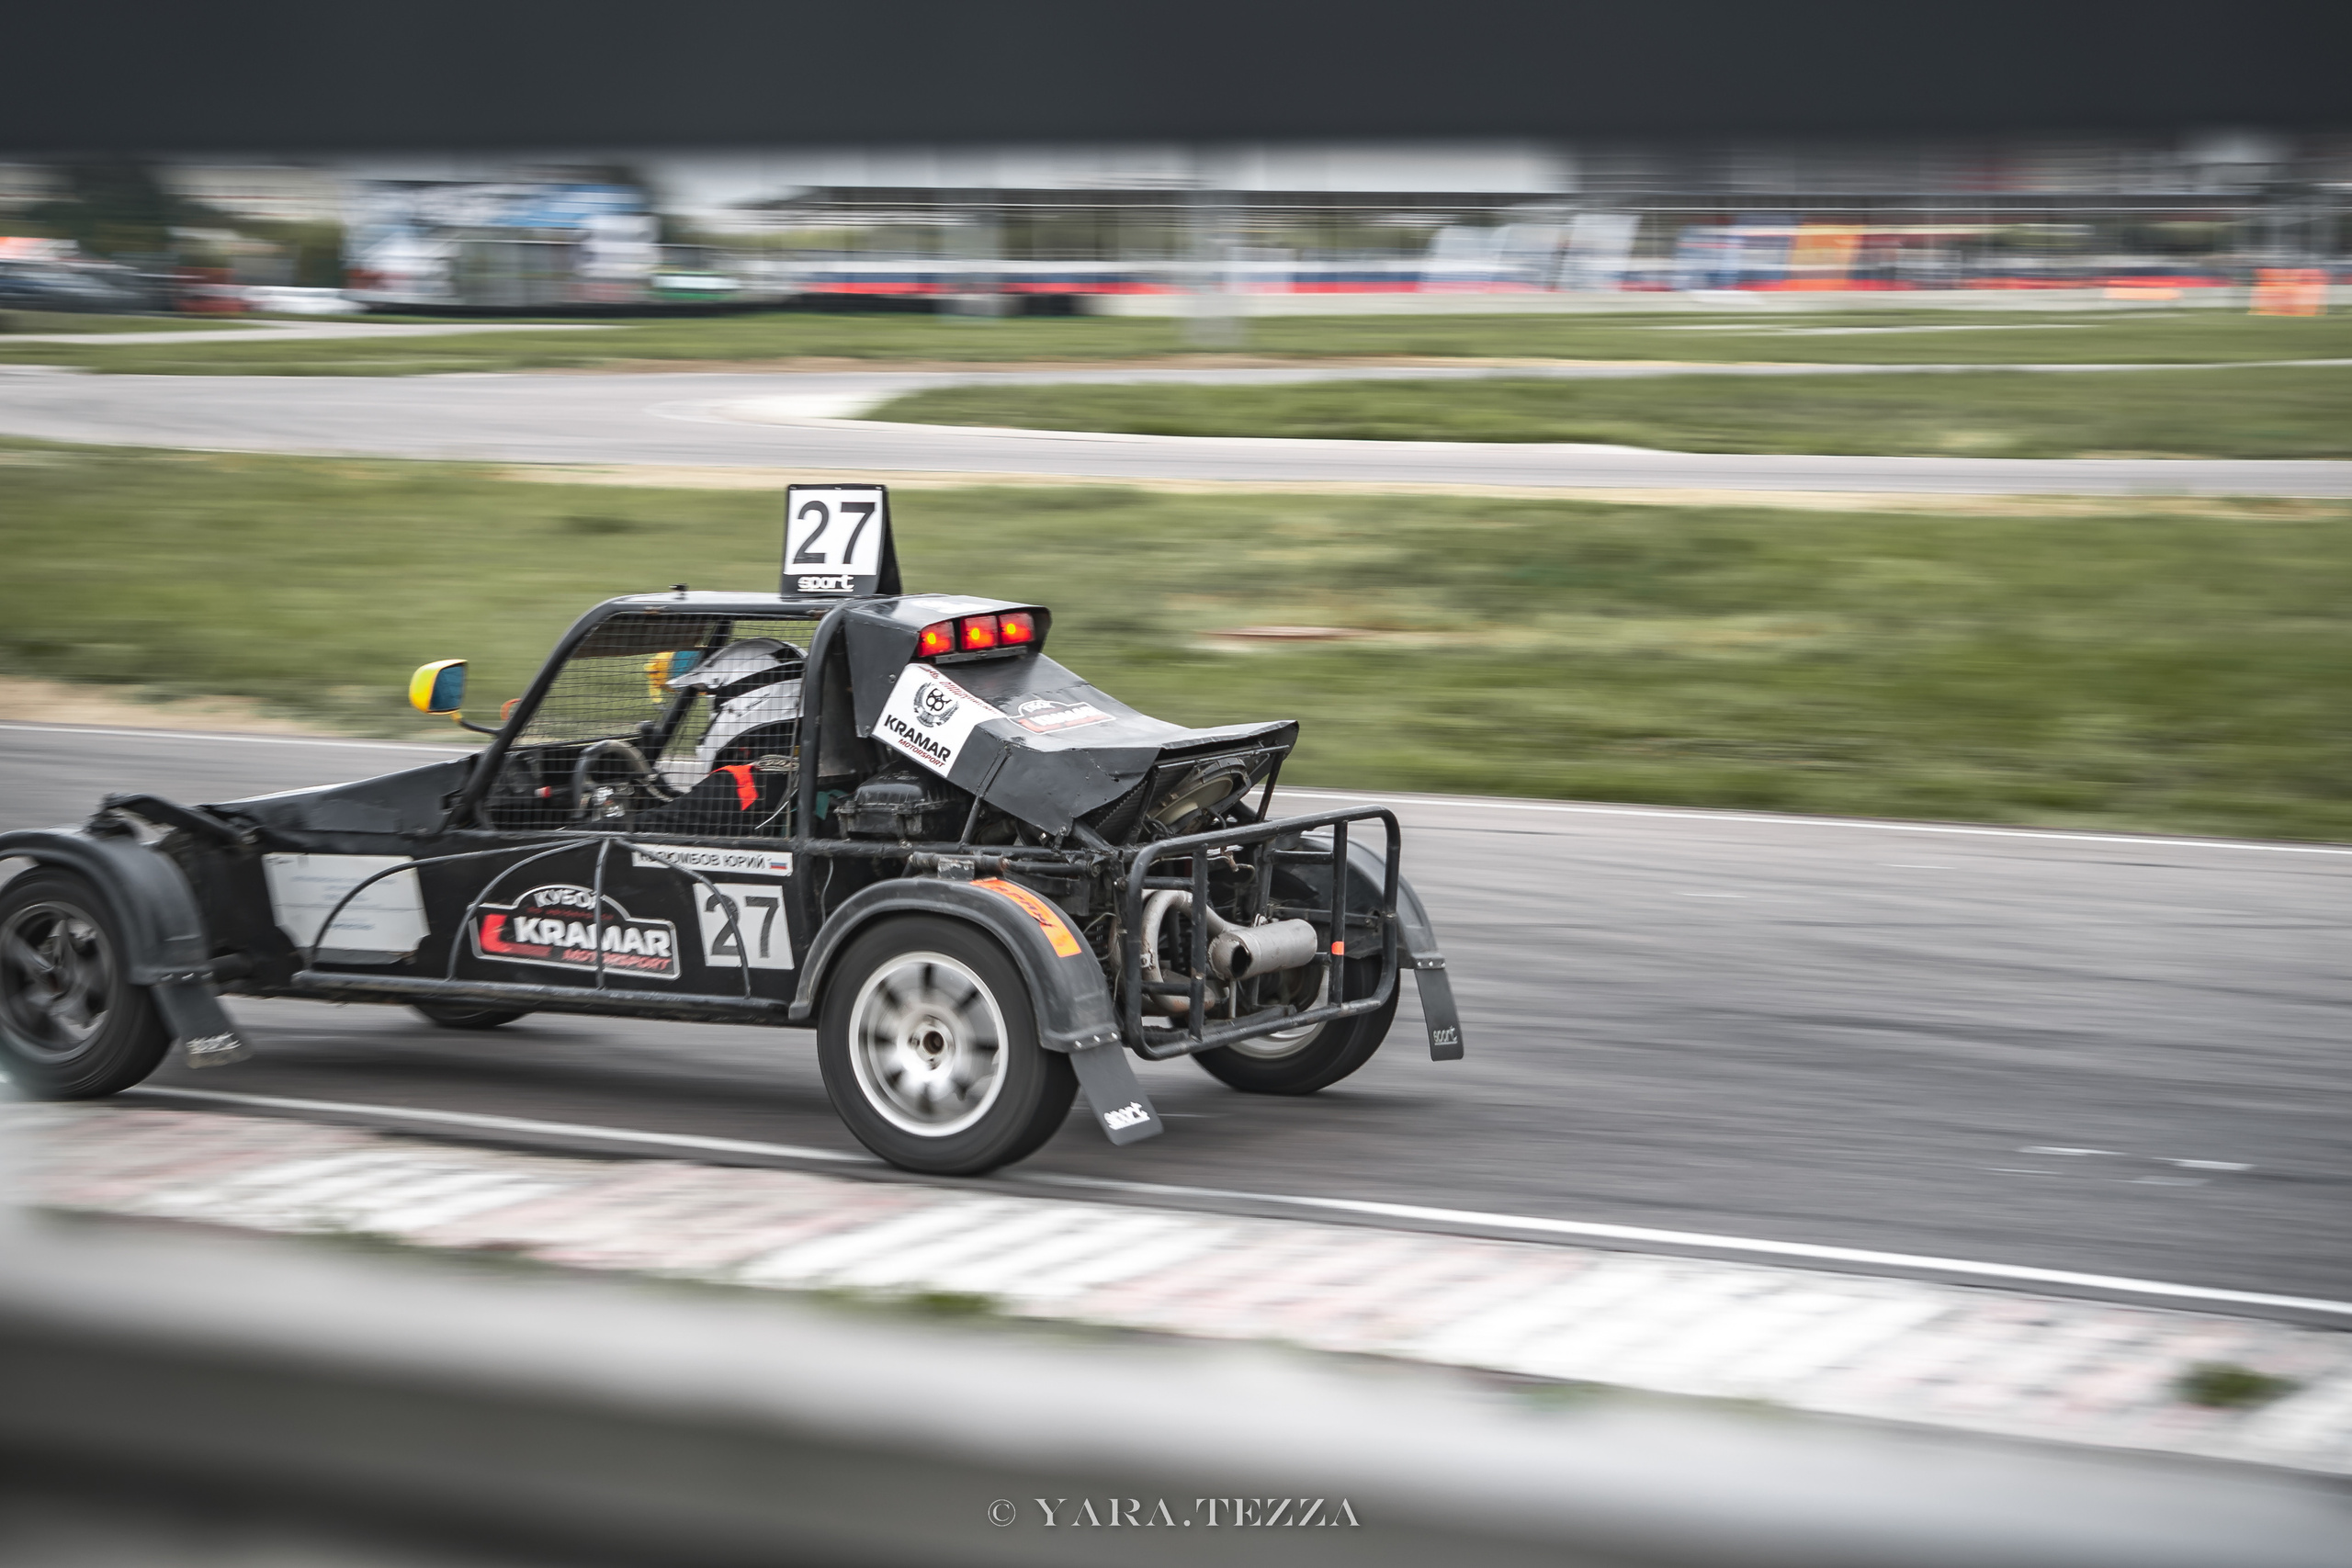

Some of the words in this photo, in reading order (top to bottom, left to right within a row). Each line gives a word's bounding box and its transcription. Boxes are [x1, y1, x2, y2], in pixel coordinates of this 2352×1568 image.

[793, 500, 876, 564] 27
[797, 575, 854, 592] sport
[884, 714, 951, 762] KRAMAR
[898, 739, 945, 768] MOTORSPORT
[723, 853, 765, 869] ЮРИЙ
[514, 916, 673, 957] KRAMAR
[704, 893, 780, 958] 27
